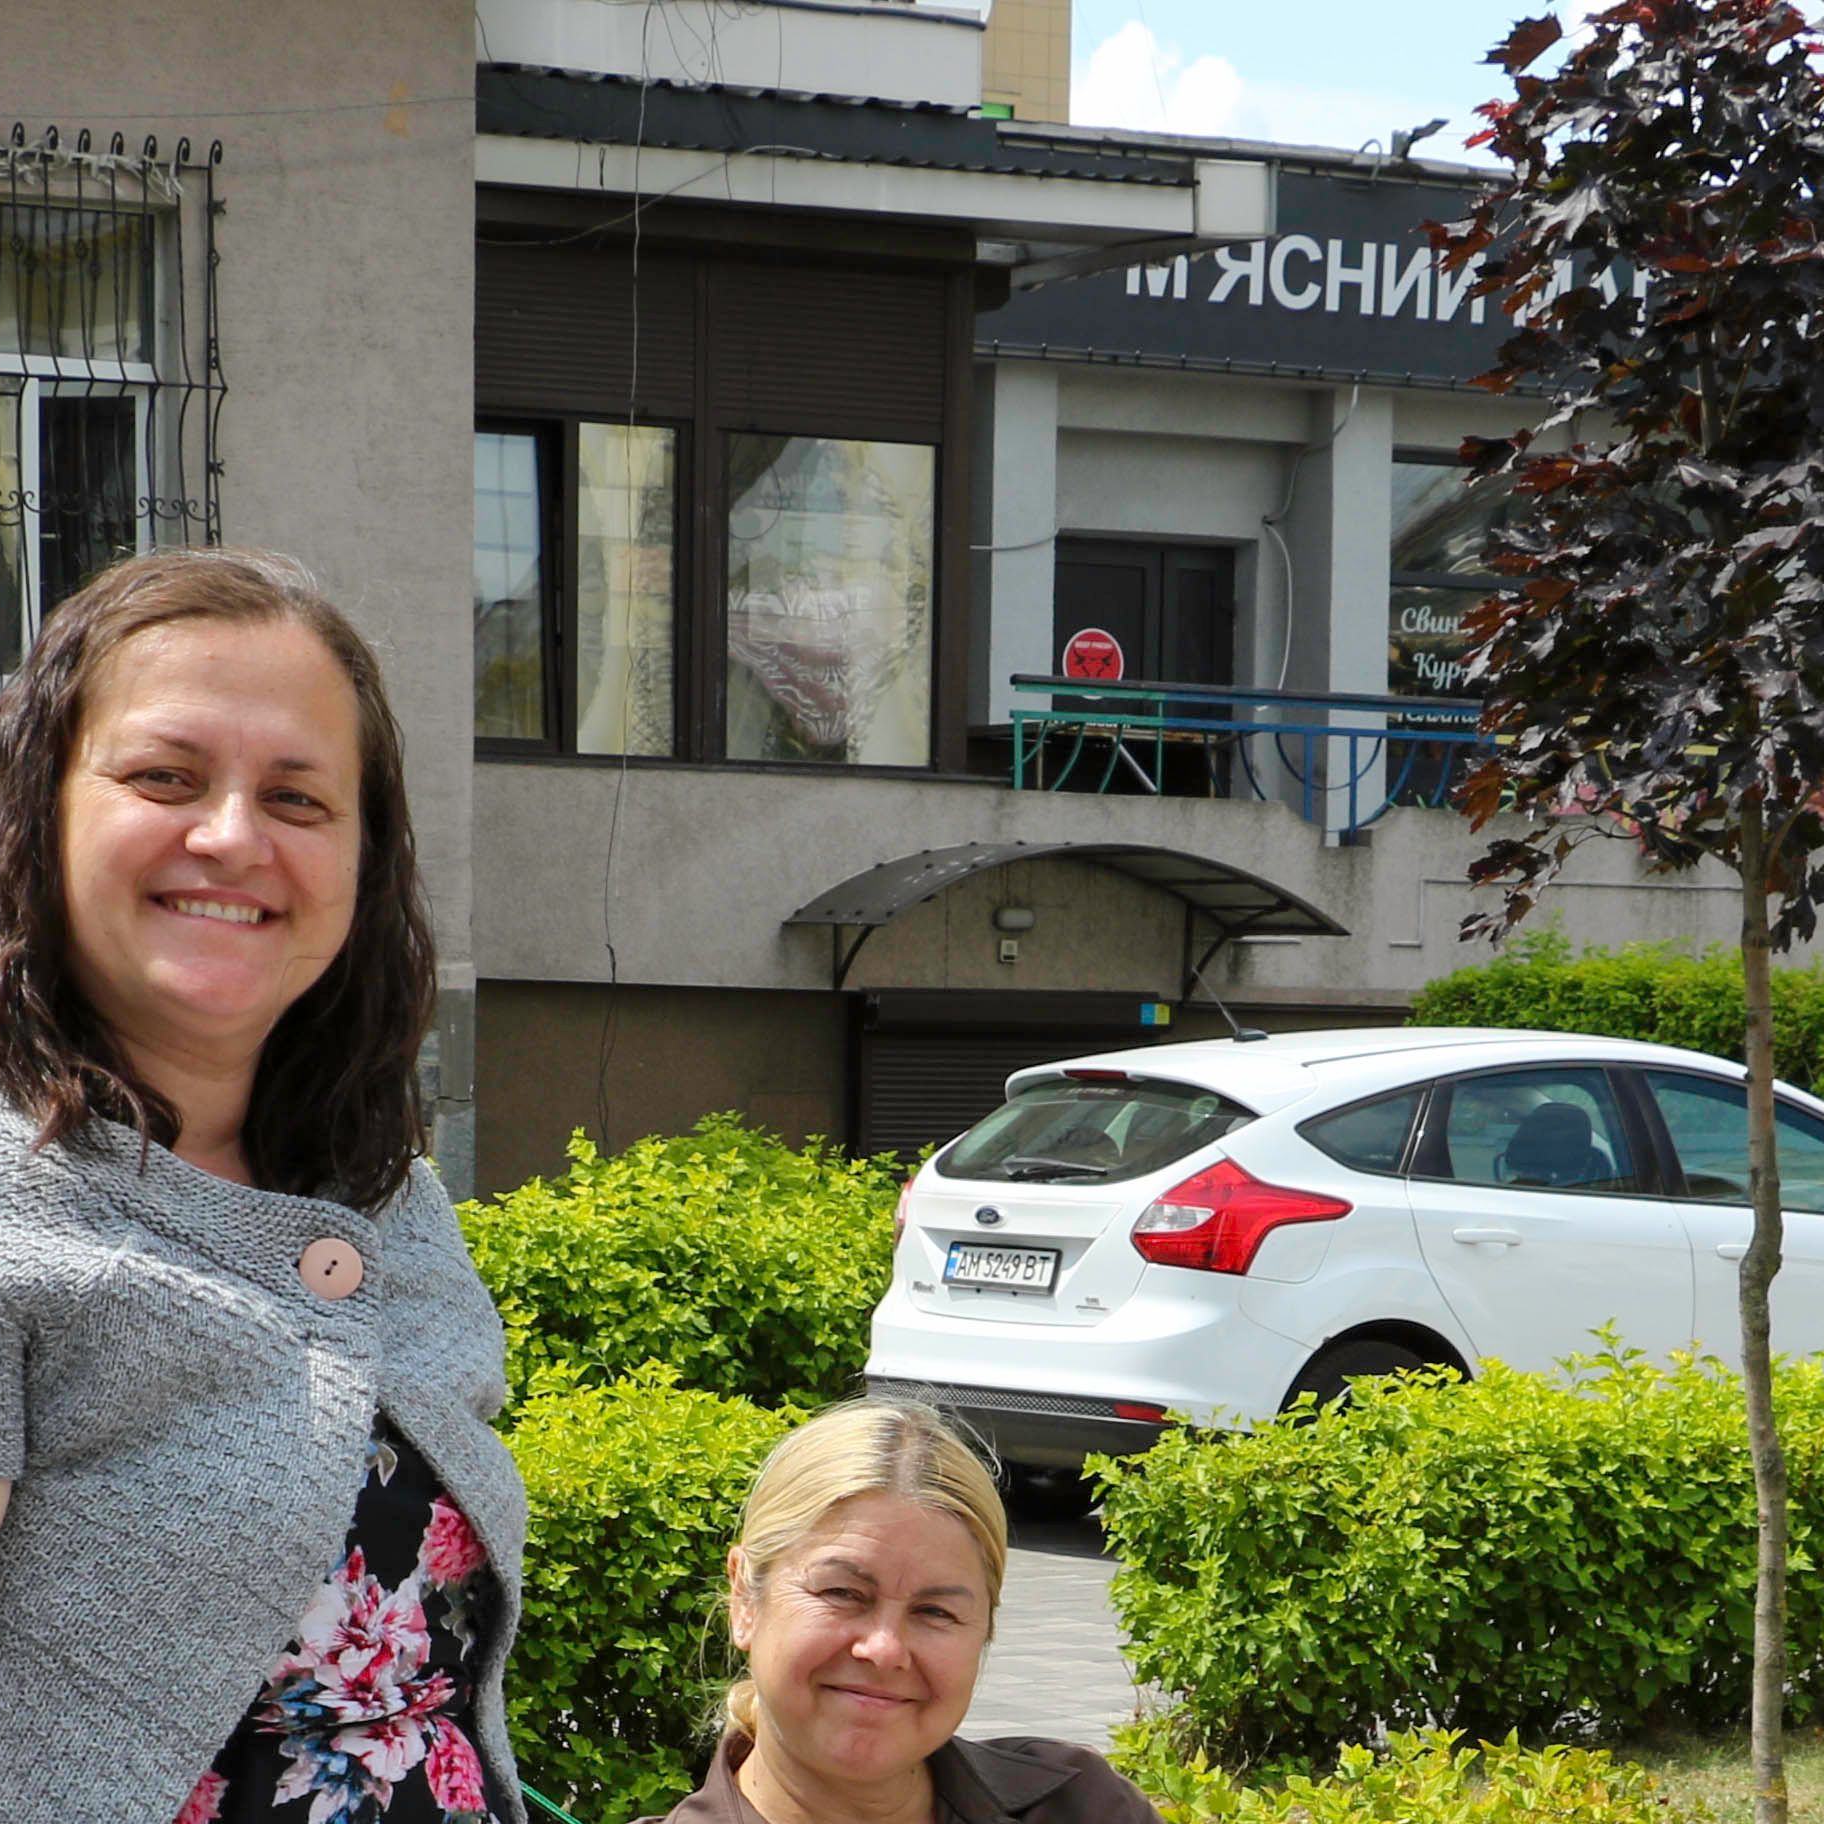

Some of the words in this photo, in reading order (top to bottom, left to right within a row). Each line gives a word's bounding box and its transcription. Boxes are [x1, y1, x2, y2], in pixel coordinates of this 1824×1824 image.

[1125, 234, 1486, 325] МЯСНИЙ
[1401, 605, 1460, 633] Свин
[1413, 652, 1462, 690] Кур
[956, 1252, 980, 1277] AM
[984, 1252, 1021, 1279] 5249
[1023, 1255, 1051, 1282] BT
